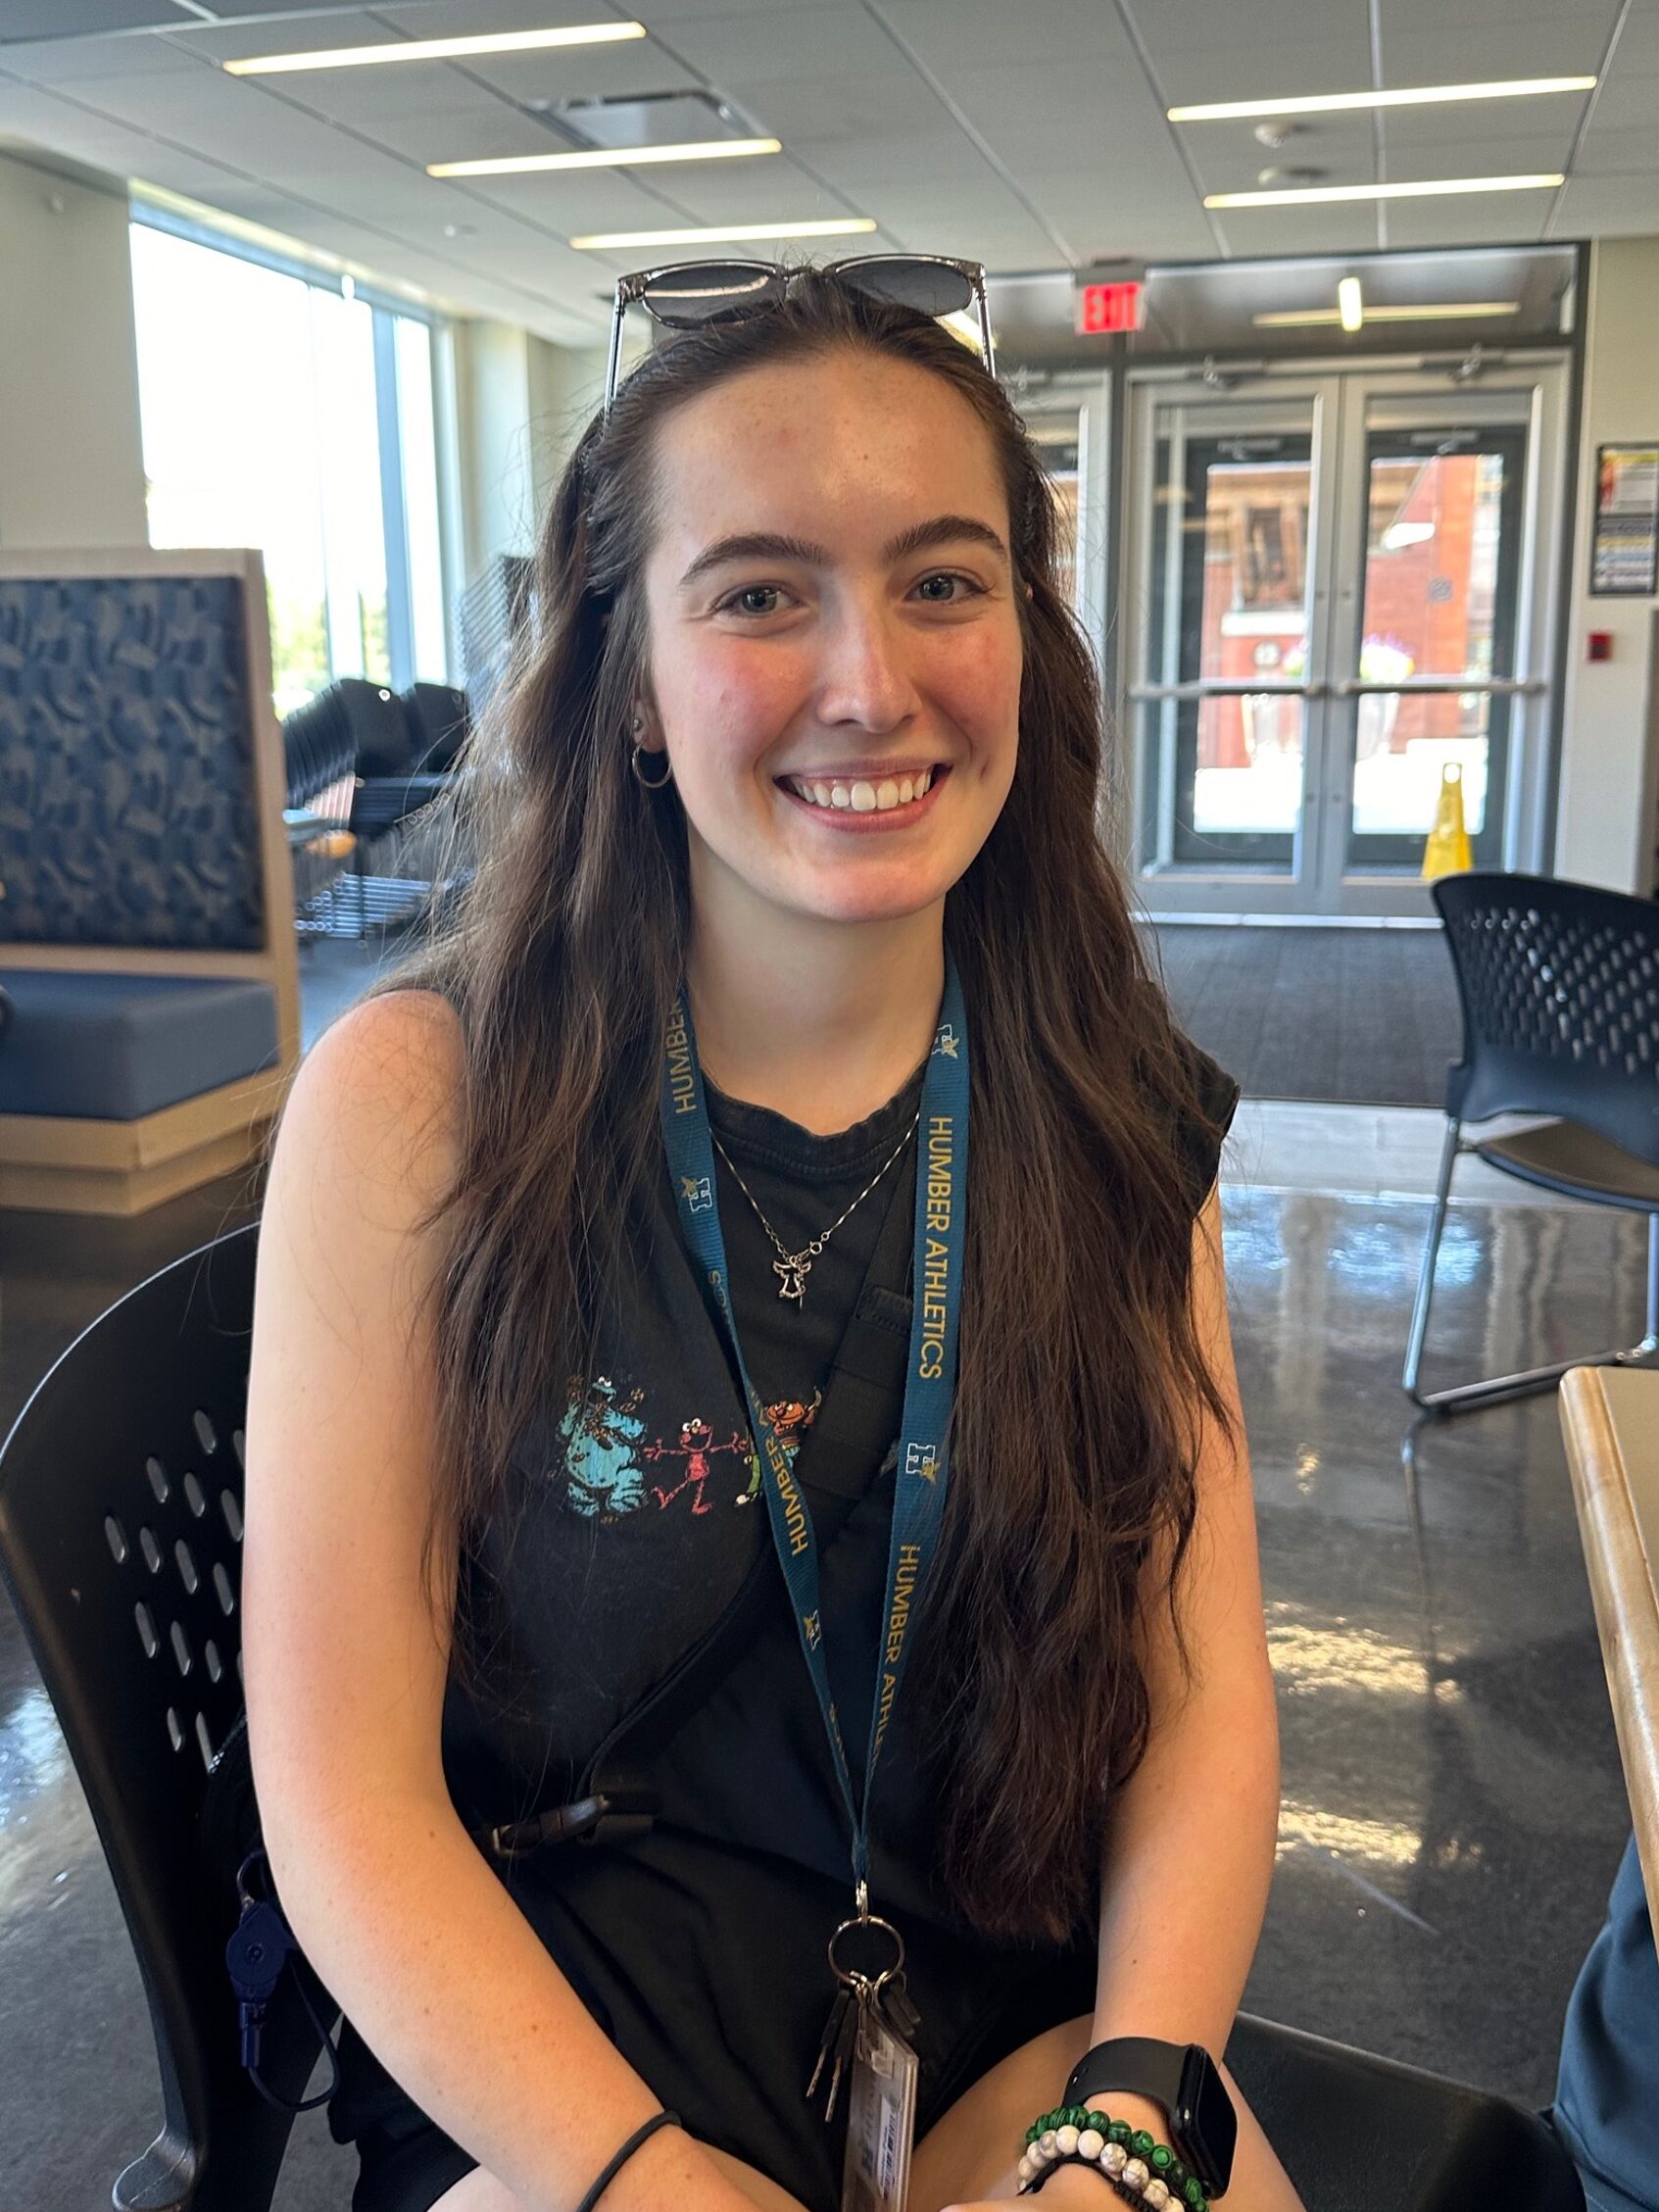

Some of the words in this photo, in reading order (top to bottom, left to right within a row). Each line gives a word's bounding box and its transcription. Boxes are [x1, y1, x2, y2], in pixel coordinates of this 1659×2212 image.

[1084, 283, 1138, 331] EXIT
[926, 1117, 952, 1232] HUMBER
[919, 1237, 950, 1379] ATHLETICS
[766, 1436, 808, 1556] HUMBER
[885, 1545, 921, 1664] HUMBER
